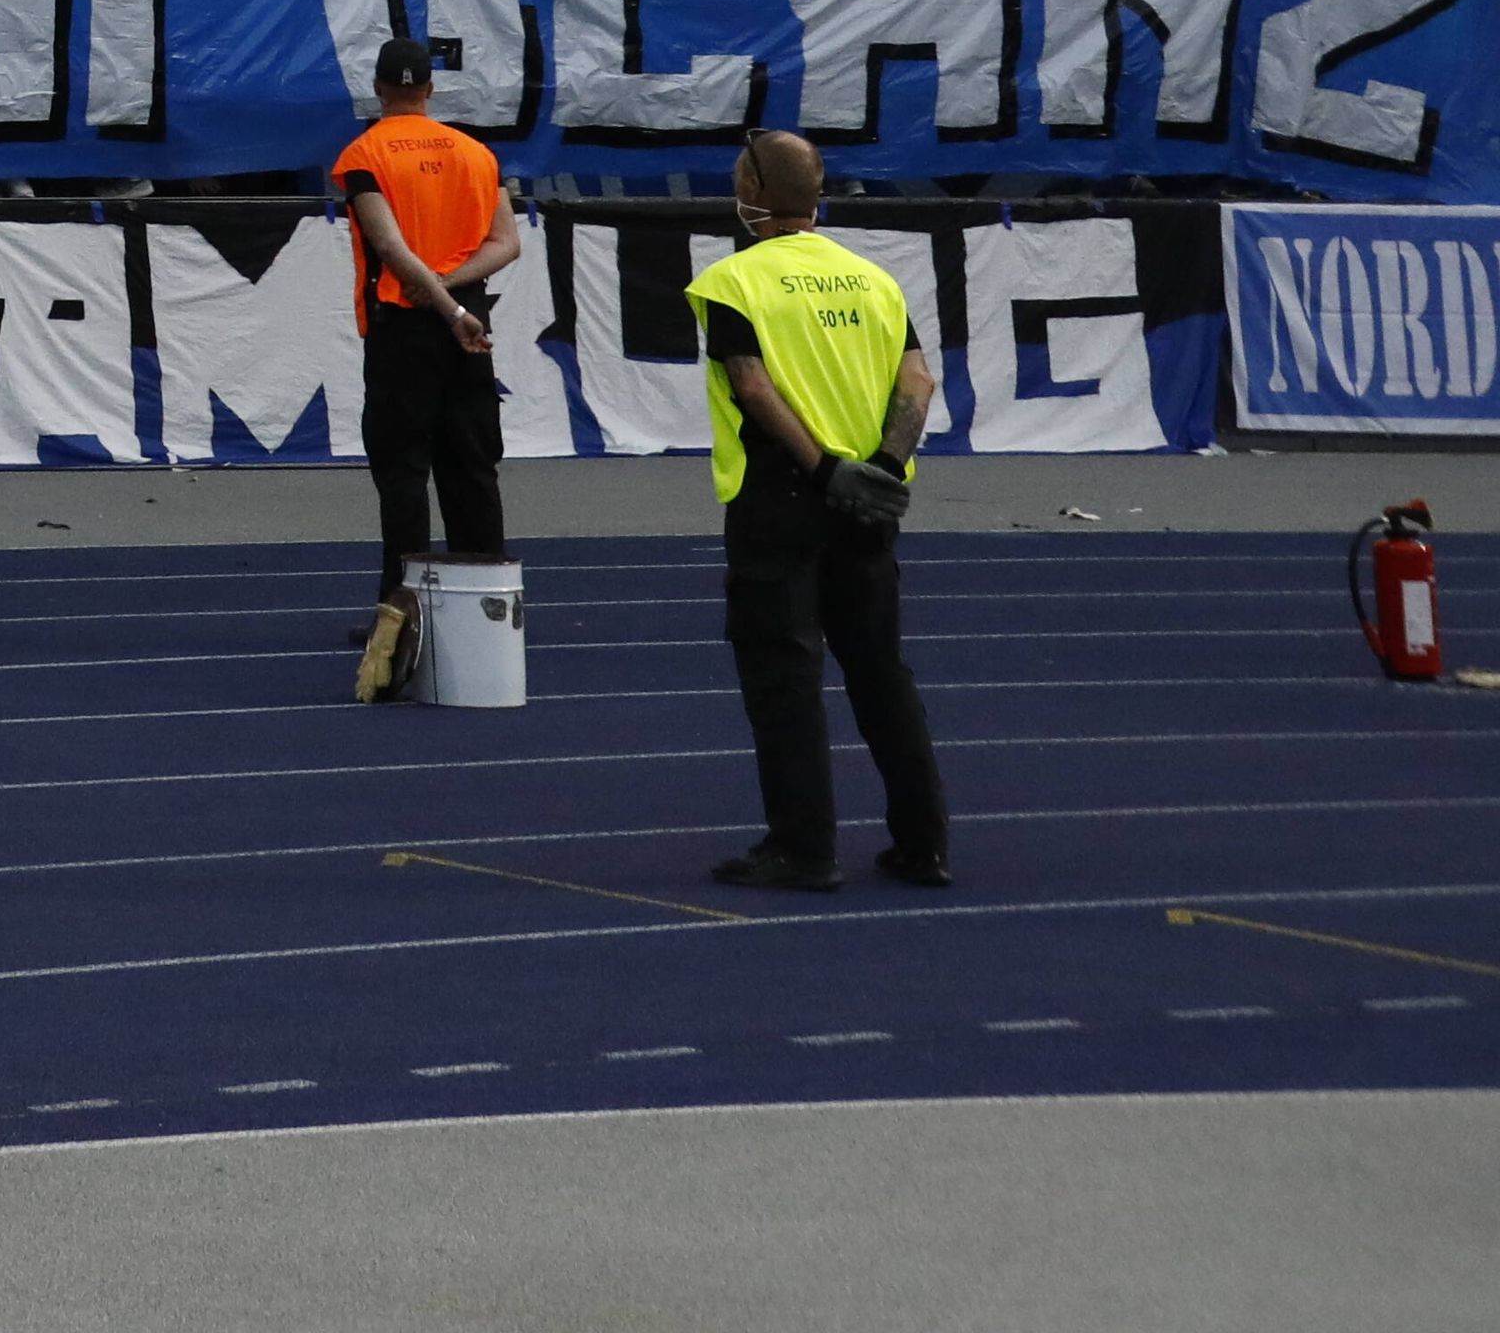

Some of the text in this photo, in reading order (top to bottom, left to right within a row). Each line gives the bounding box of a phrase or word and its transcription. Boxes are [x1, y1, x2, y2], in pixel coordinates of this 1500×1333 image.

[387, 138, 456, 153] STEWARD
[780, 274, 871, 294] STEWARD
[817, 308, 860, 328] 5014
[1257, 235, 1500, 400] NORD
